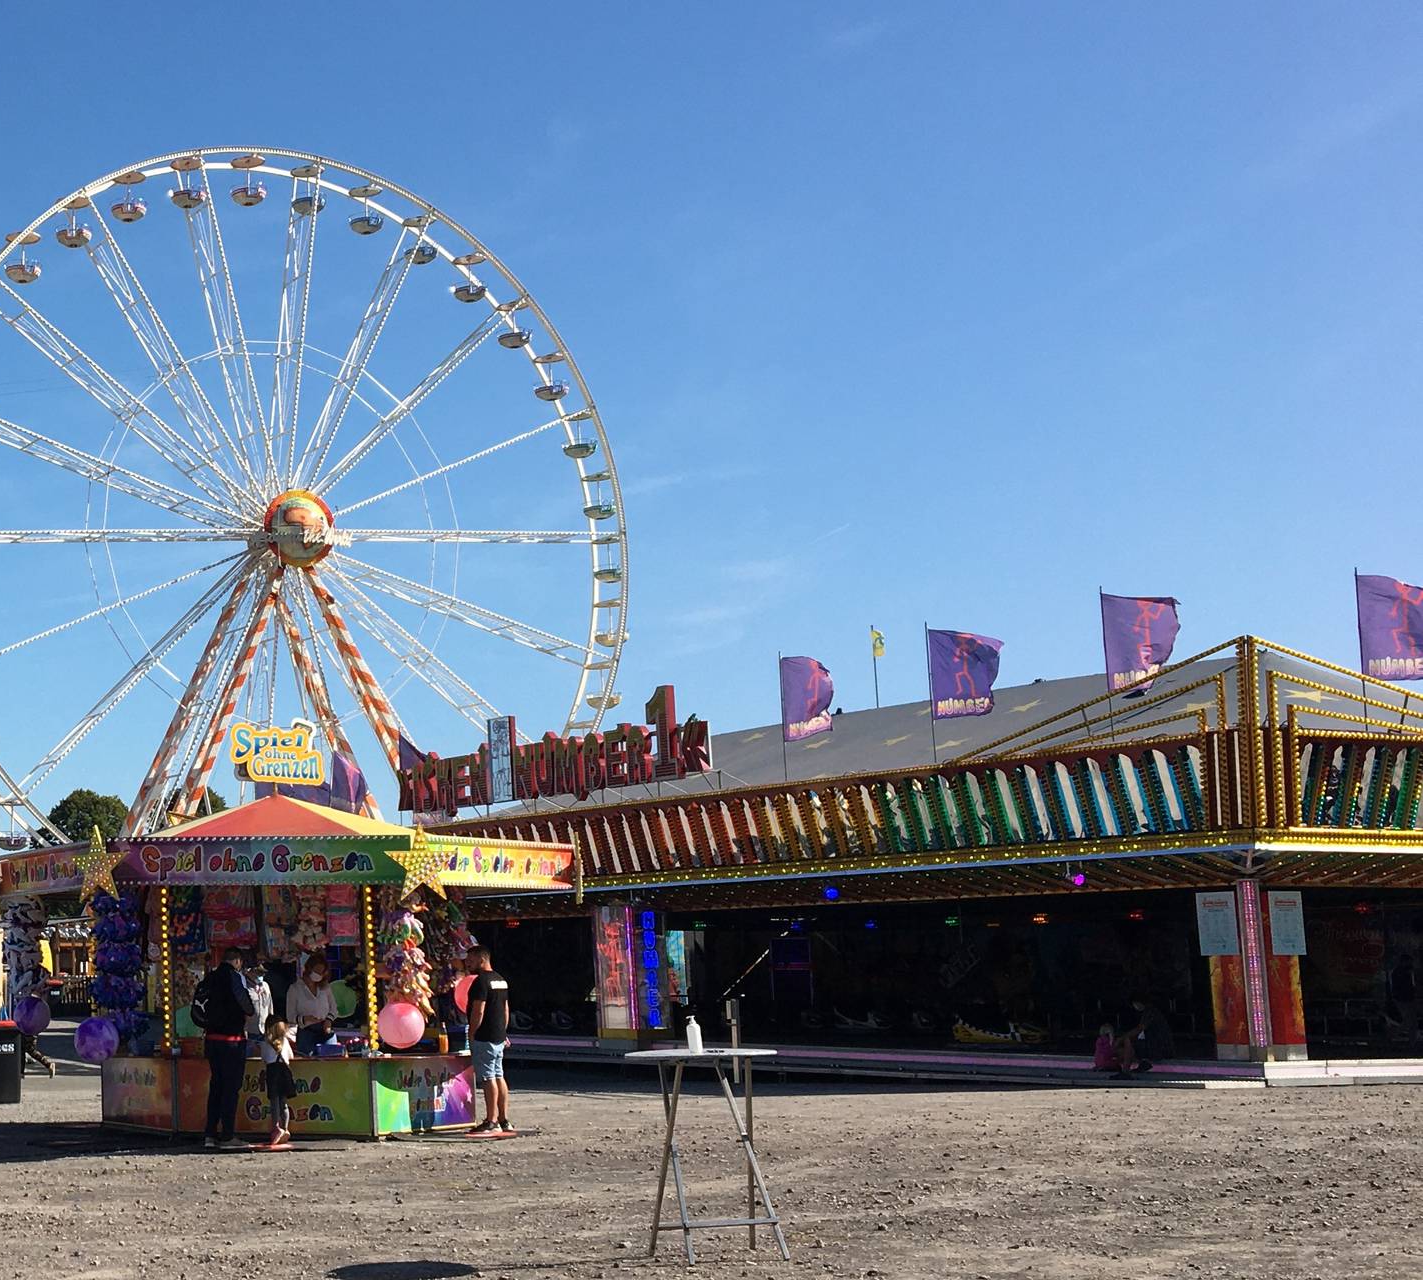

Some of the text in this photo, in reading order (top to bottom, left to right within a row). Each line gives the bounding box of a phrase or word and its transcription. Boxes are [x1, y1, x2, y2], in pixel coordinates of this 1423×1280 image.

[235, 728, 303, 758] Spiel
[265, 747, 296, 760] ohne
[253, 756, 320, 780] Grenzen
[512, 722, 651, 801] NUMBER
[140, 844, 374, 882] Spiel ohne Grenzen
[245, 1095, 335, 1122] Grnzen
